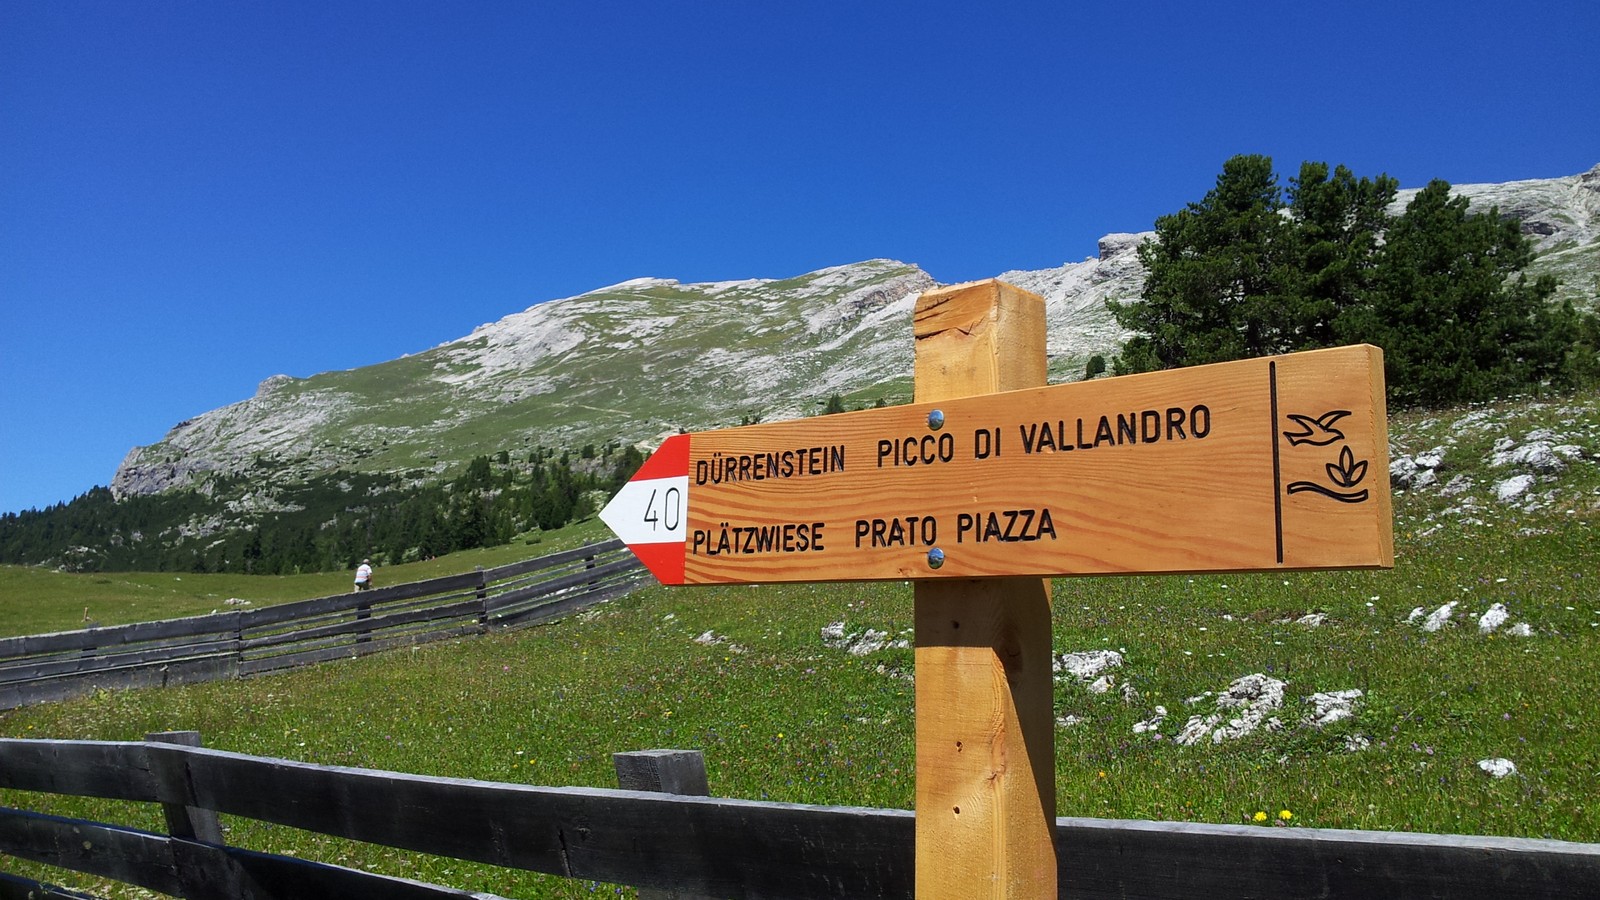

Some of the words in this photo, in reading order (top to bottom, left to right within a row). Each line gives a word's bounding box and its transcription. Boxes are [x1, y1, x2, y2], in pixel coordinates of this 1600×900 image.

[696, 444, 846, 486] DÜRRENSTEIN
[877, 432, 954, 468] PICCO
[974, 428, 1001, 460] DI
[1024, 404, 1211, 454] VALLANDRO
[644, 487, 680, 532] 40
[692, 521, 825, 556] PLÄTZWIESE
[856, 515, 937, 549] PRATO
[957, 508, 1056, 544] PIAZZA
